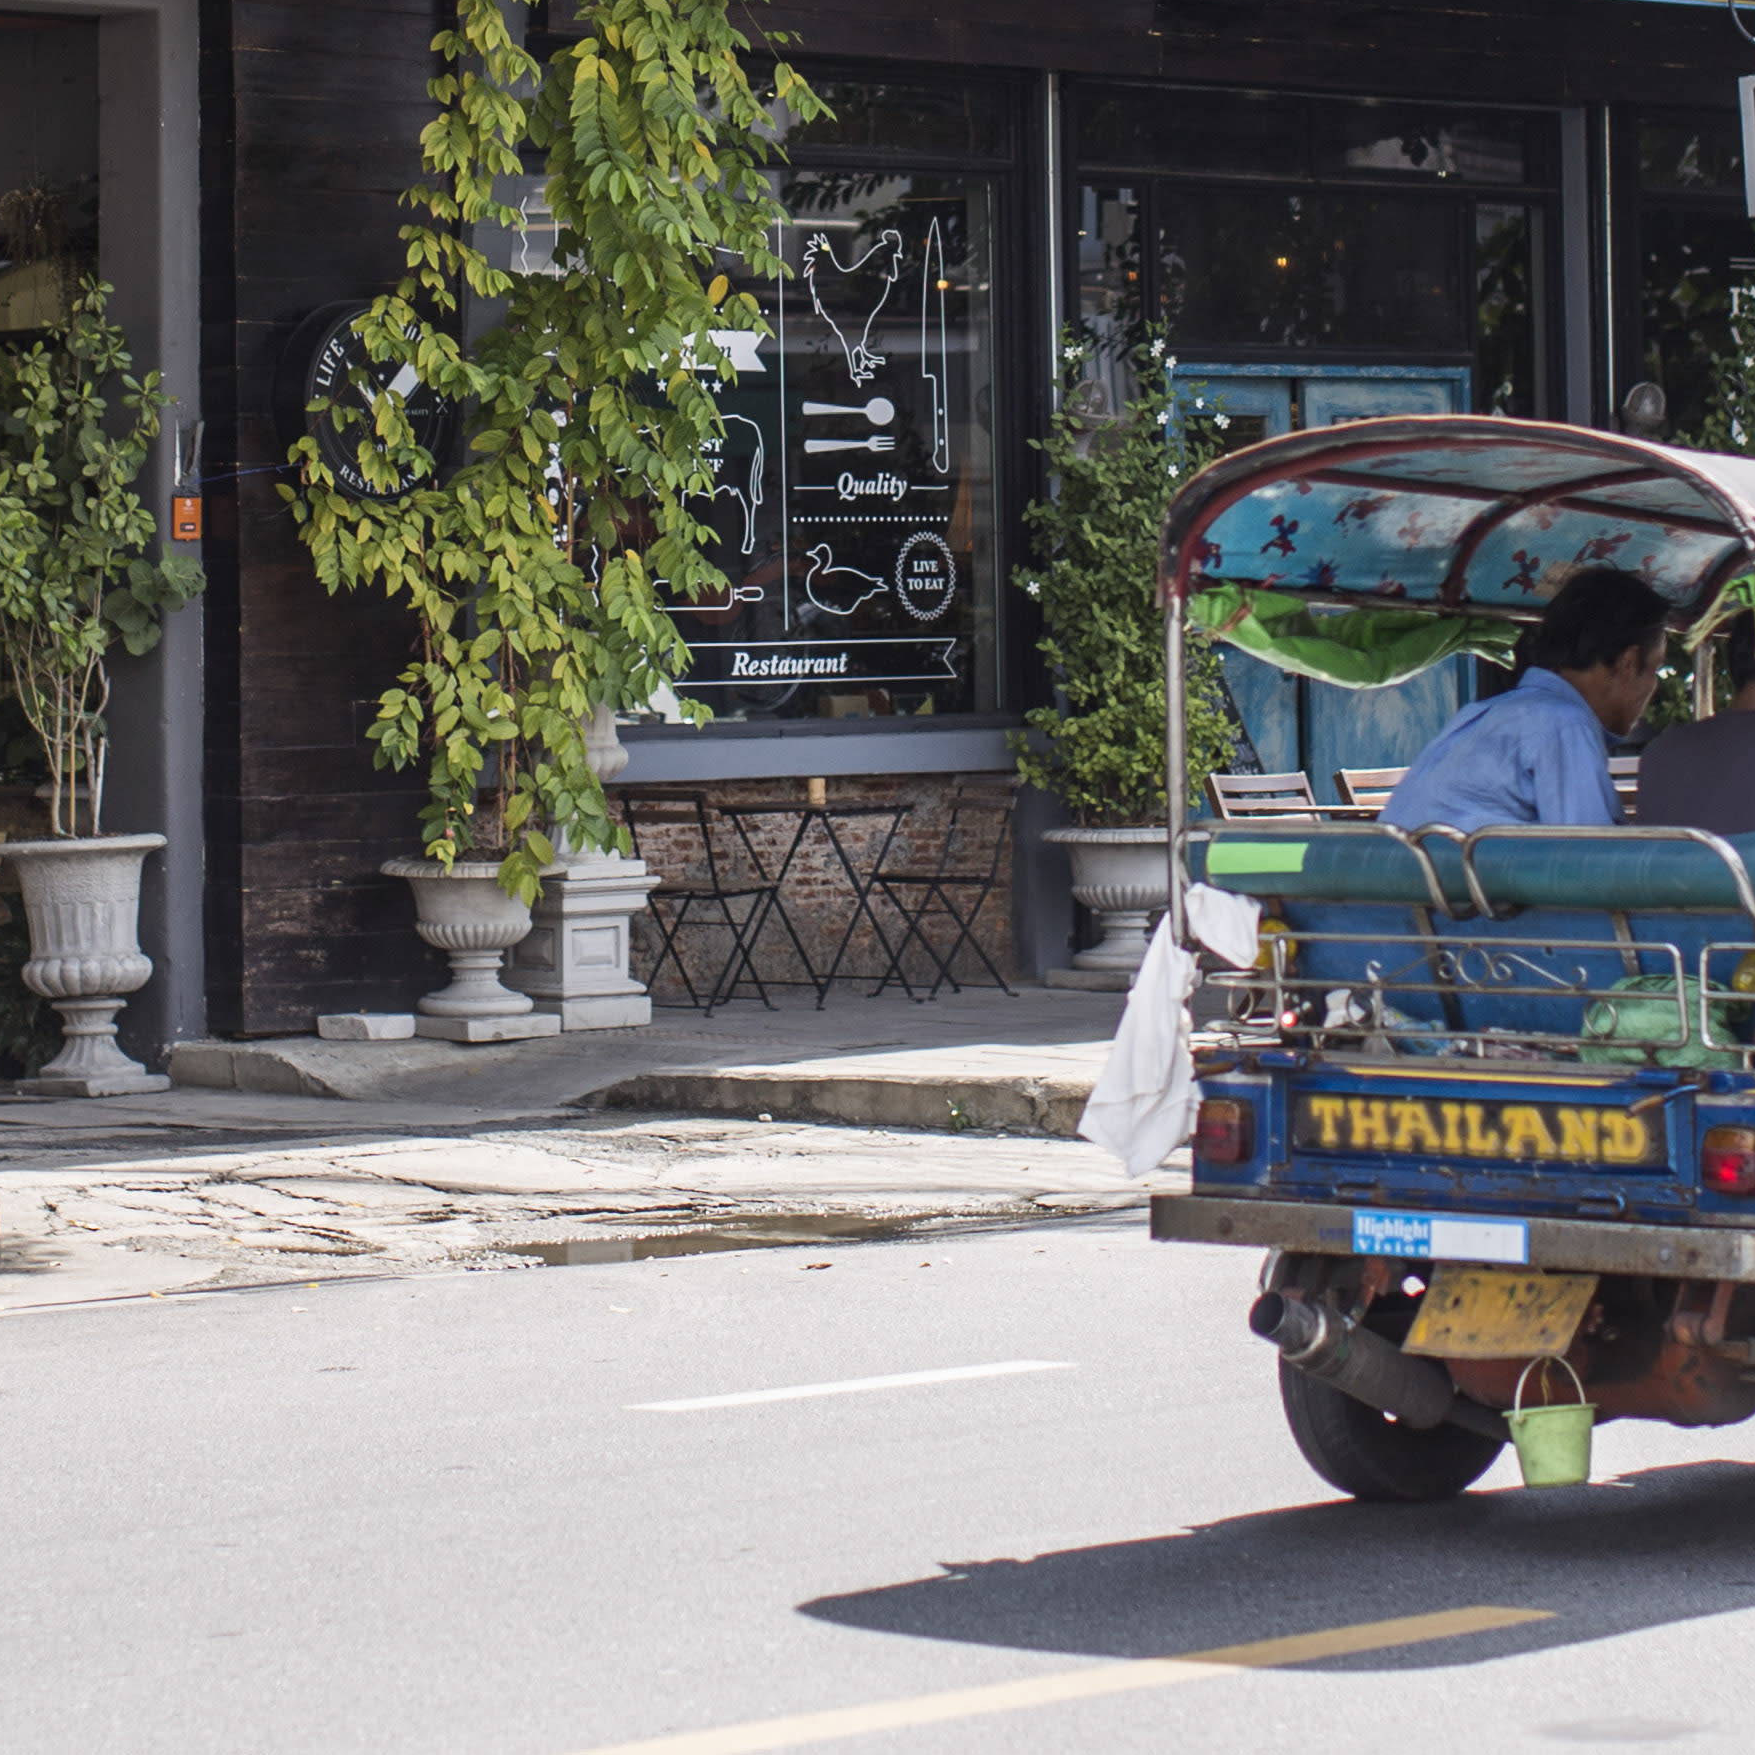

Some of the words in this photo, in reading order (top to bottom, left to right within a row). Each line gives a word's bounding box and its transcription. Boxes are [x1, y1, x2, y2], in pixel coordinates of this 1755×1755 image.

[316, 338, 345, 387] LIFE
[837, 472, 907, 501] Quality
[913, 560, 939, 573] LIVE
[907, 578, 923, 590] TO
[924, 578, 945, 590] EAT
[731, 652, 849, 676] Restaurant
[1310, 1096, 1646, 1164] THAILAND
[1357, 1216, 1429, 1243] Highlight
[1358, 1238, 1429, 1255] Vision
